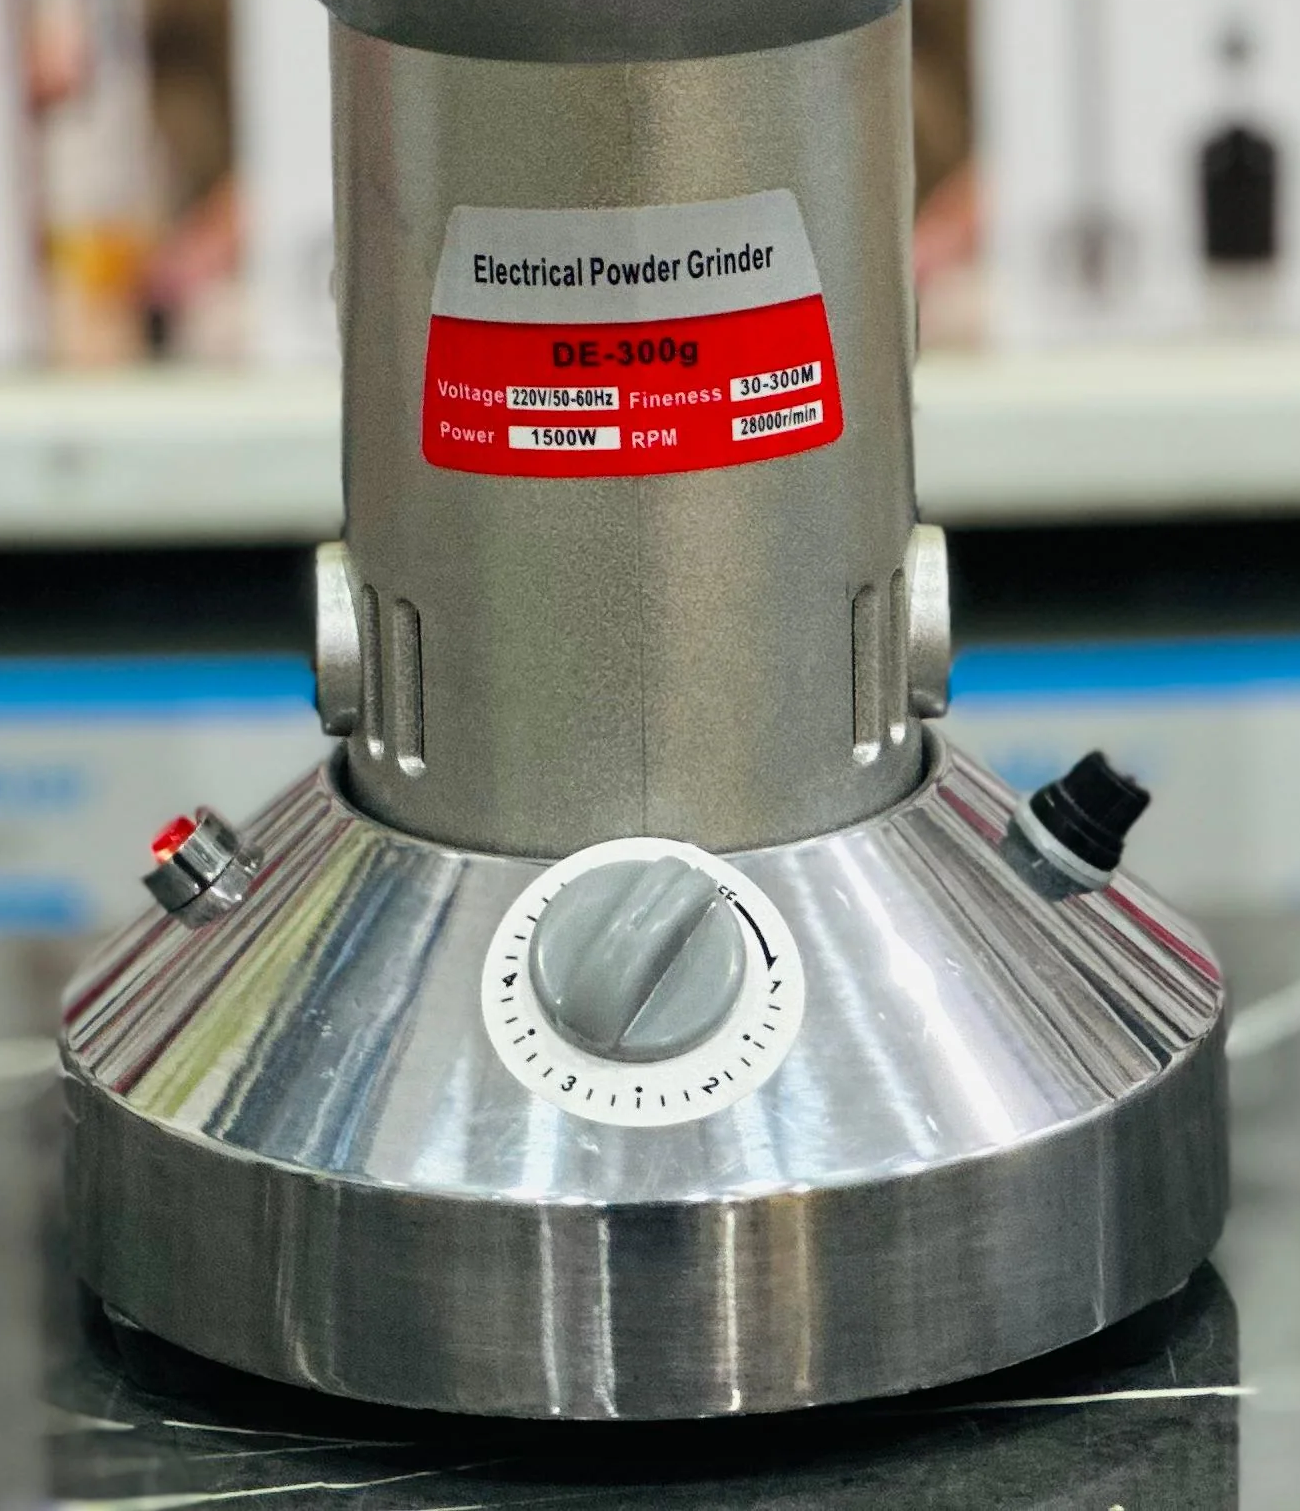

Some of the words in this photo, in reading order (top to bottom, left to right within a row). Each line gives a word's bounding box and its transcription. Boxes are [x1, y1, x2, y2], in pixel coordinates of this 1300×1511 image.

[474, 254, 583, 286] Electrical
[590, 254, 680, 286] Powder
[687, 243, 773, 279] Grinder
[552, 337, 698, 367] DE-300g
[437, 379, 505, 407] Voltage
[512, 388, 614, 406] 220V/50-60Hz
[629, 387, 722, 409] Fineness
[740, 365, 814, 396] 30-300M
[440, 421, 495, 444] Power
[531, 428, 597, 446] 1500W
[632, 428, 678, 449] RPM
[740, 405, 817, 436] 28000r/min
[502, 973, 517, 987] 4
[561, 1076, 577, 1091] 3
[702, 1077, 720, 1094] 2
